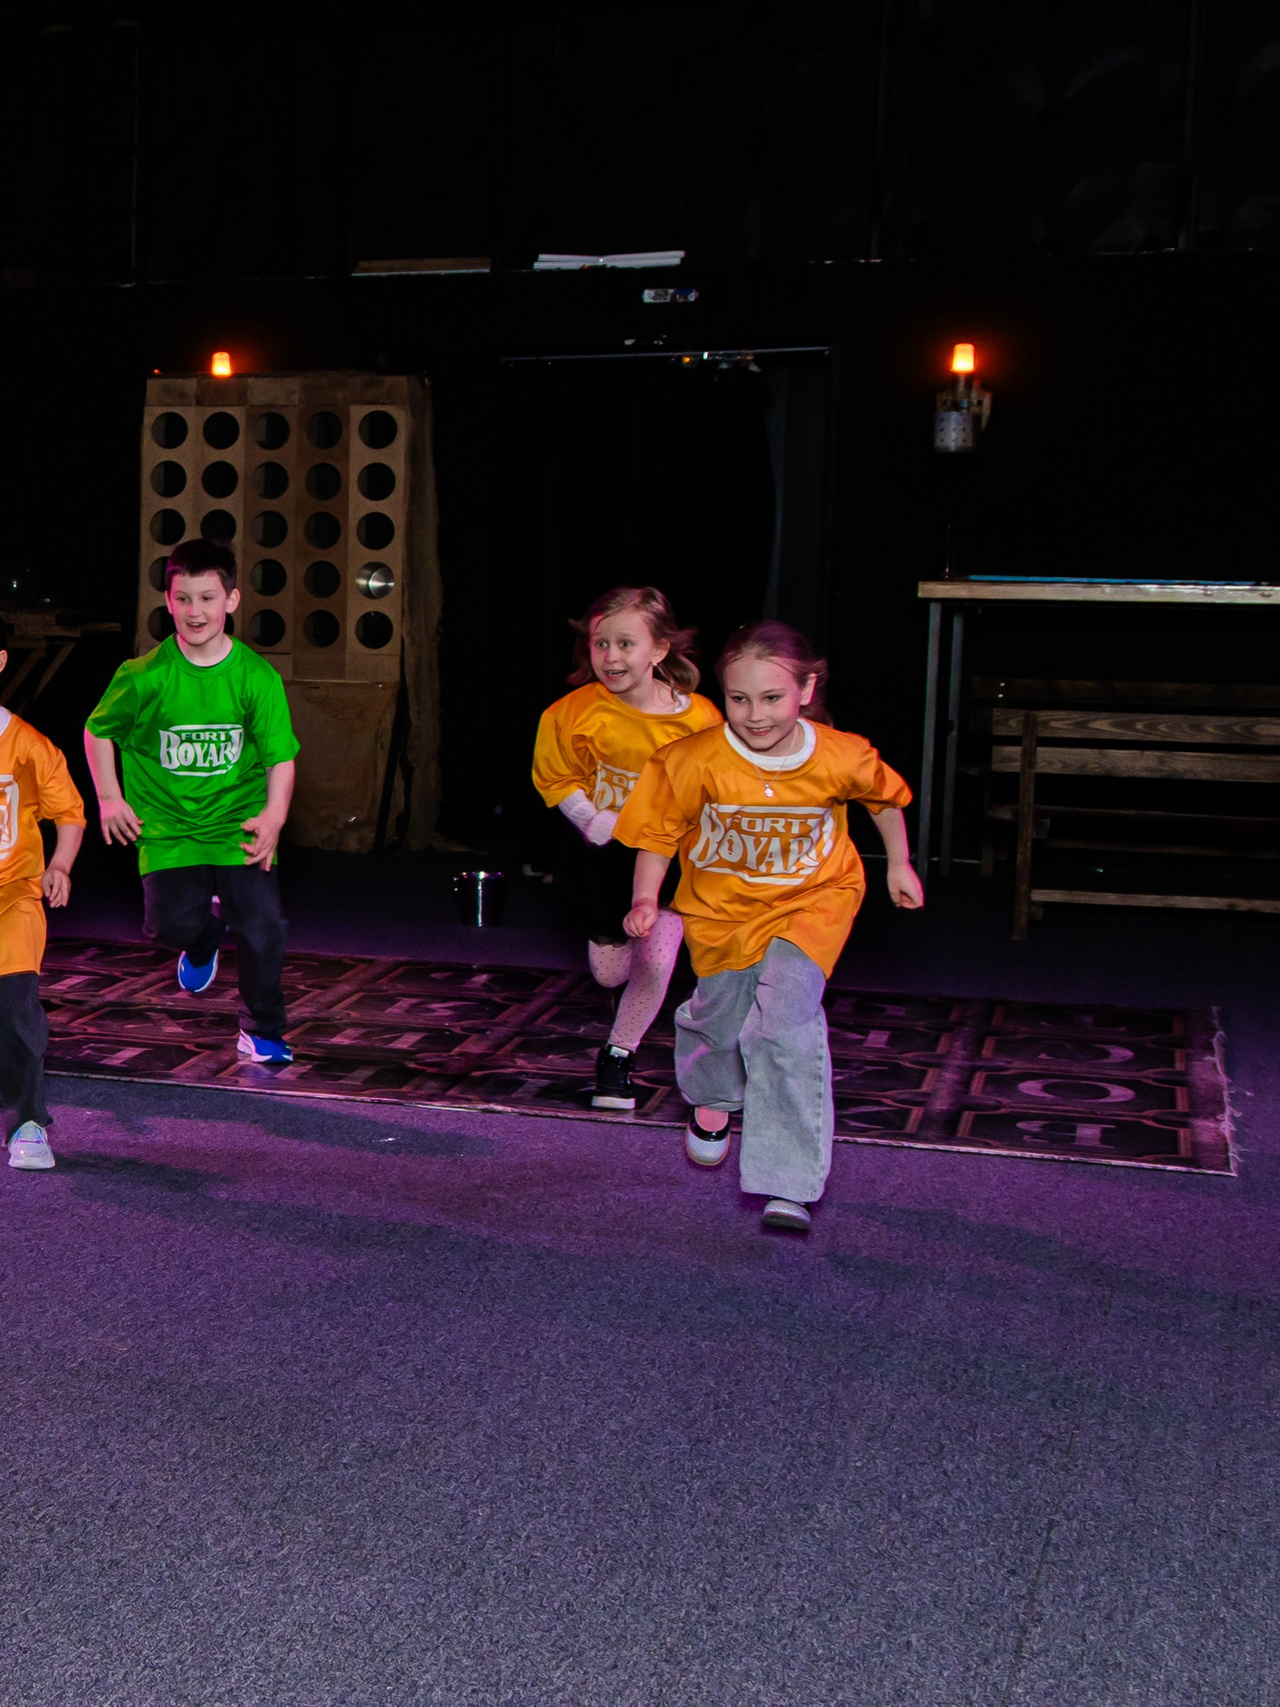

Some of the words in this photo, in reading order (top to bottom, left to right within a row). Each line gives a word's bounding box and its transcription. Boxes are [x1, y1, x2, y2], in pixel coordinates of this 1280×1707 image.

[159, 728, 244, 770] BOYARD
[181, 731, 228, 741] FORT
[725, 815, 805, 834] FORT
[688, 803, 836, 876] BOYARD
[1017, 1077, 1136, 1103] О
[1016, 1119, 1118, 1149] Б
